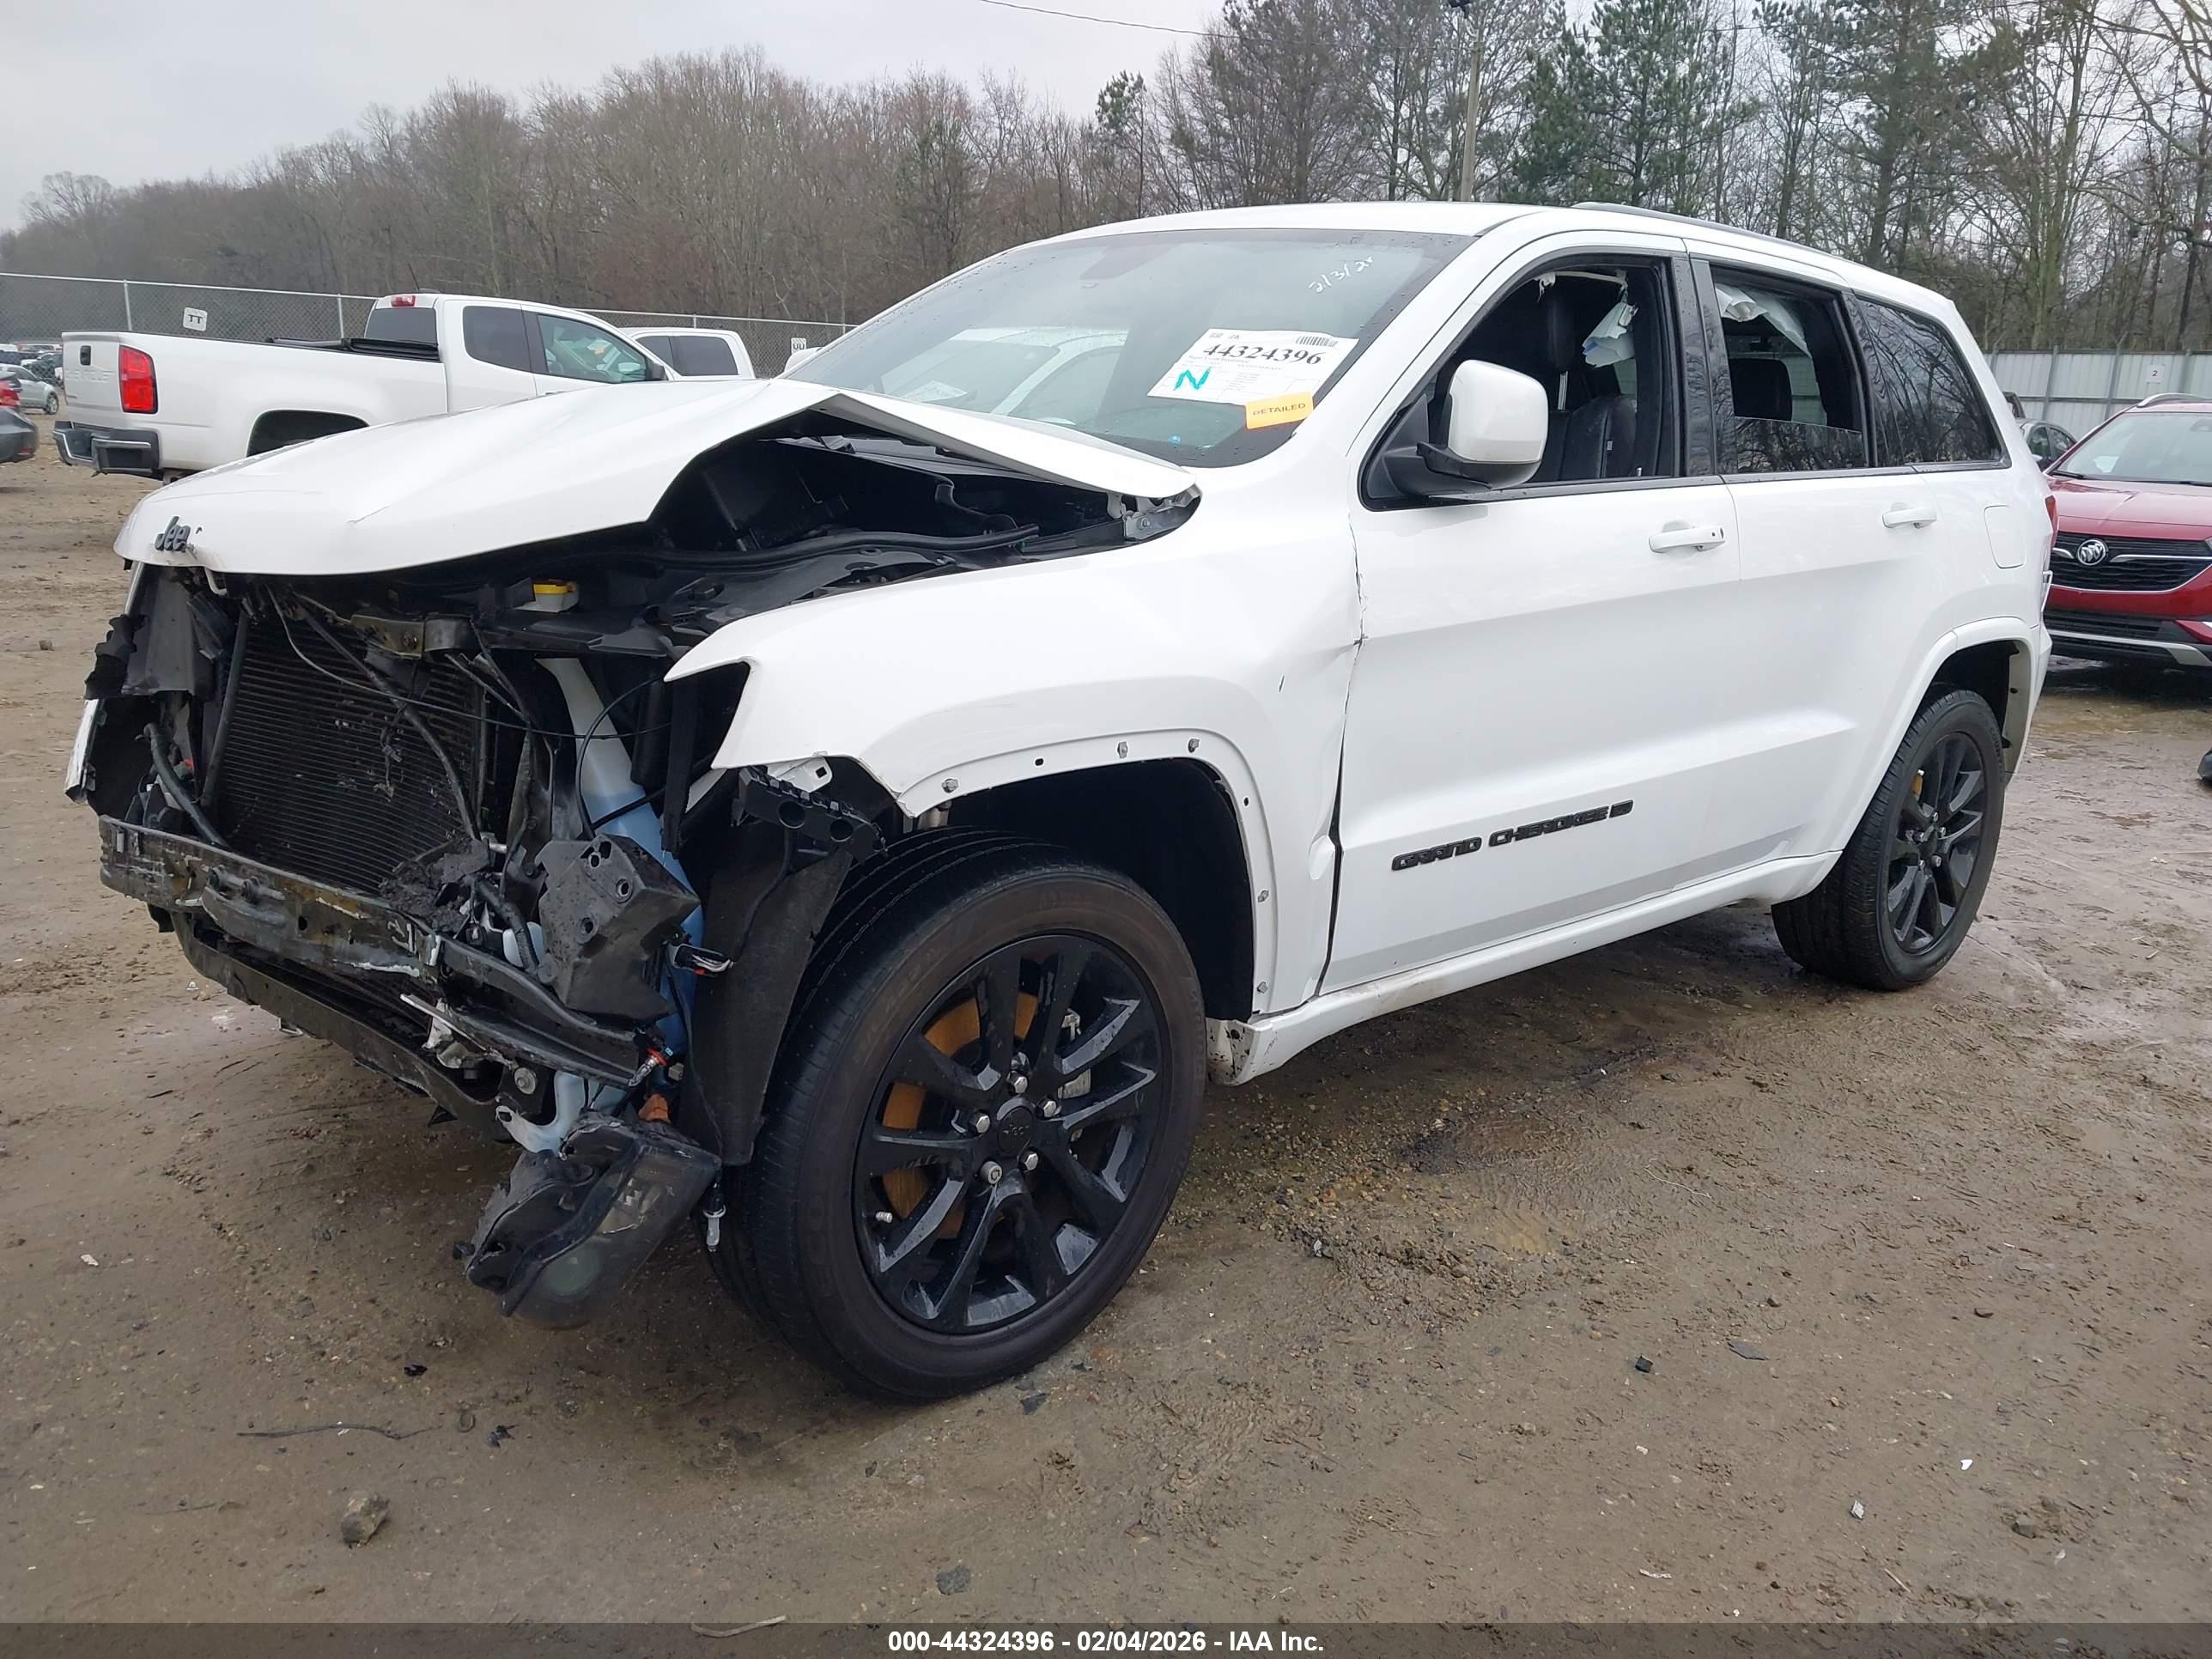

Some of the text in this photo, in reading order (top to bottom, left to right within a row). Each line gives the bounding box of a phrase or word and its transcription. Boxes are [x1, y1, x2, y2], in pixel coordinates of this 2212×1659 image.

[187, 313, 204, 325] TT
[1203, 343, 1326, 365] 44324396
[1173, 366, 1212, 392] N
[1252, 402, 1307, 416] DETAILED
[155, 515, 193, 552] Jee
[1391, 805, 1610, 871] GRAND CHEROKEE
